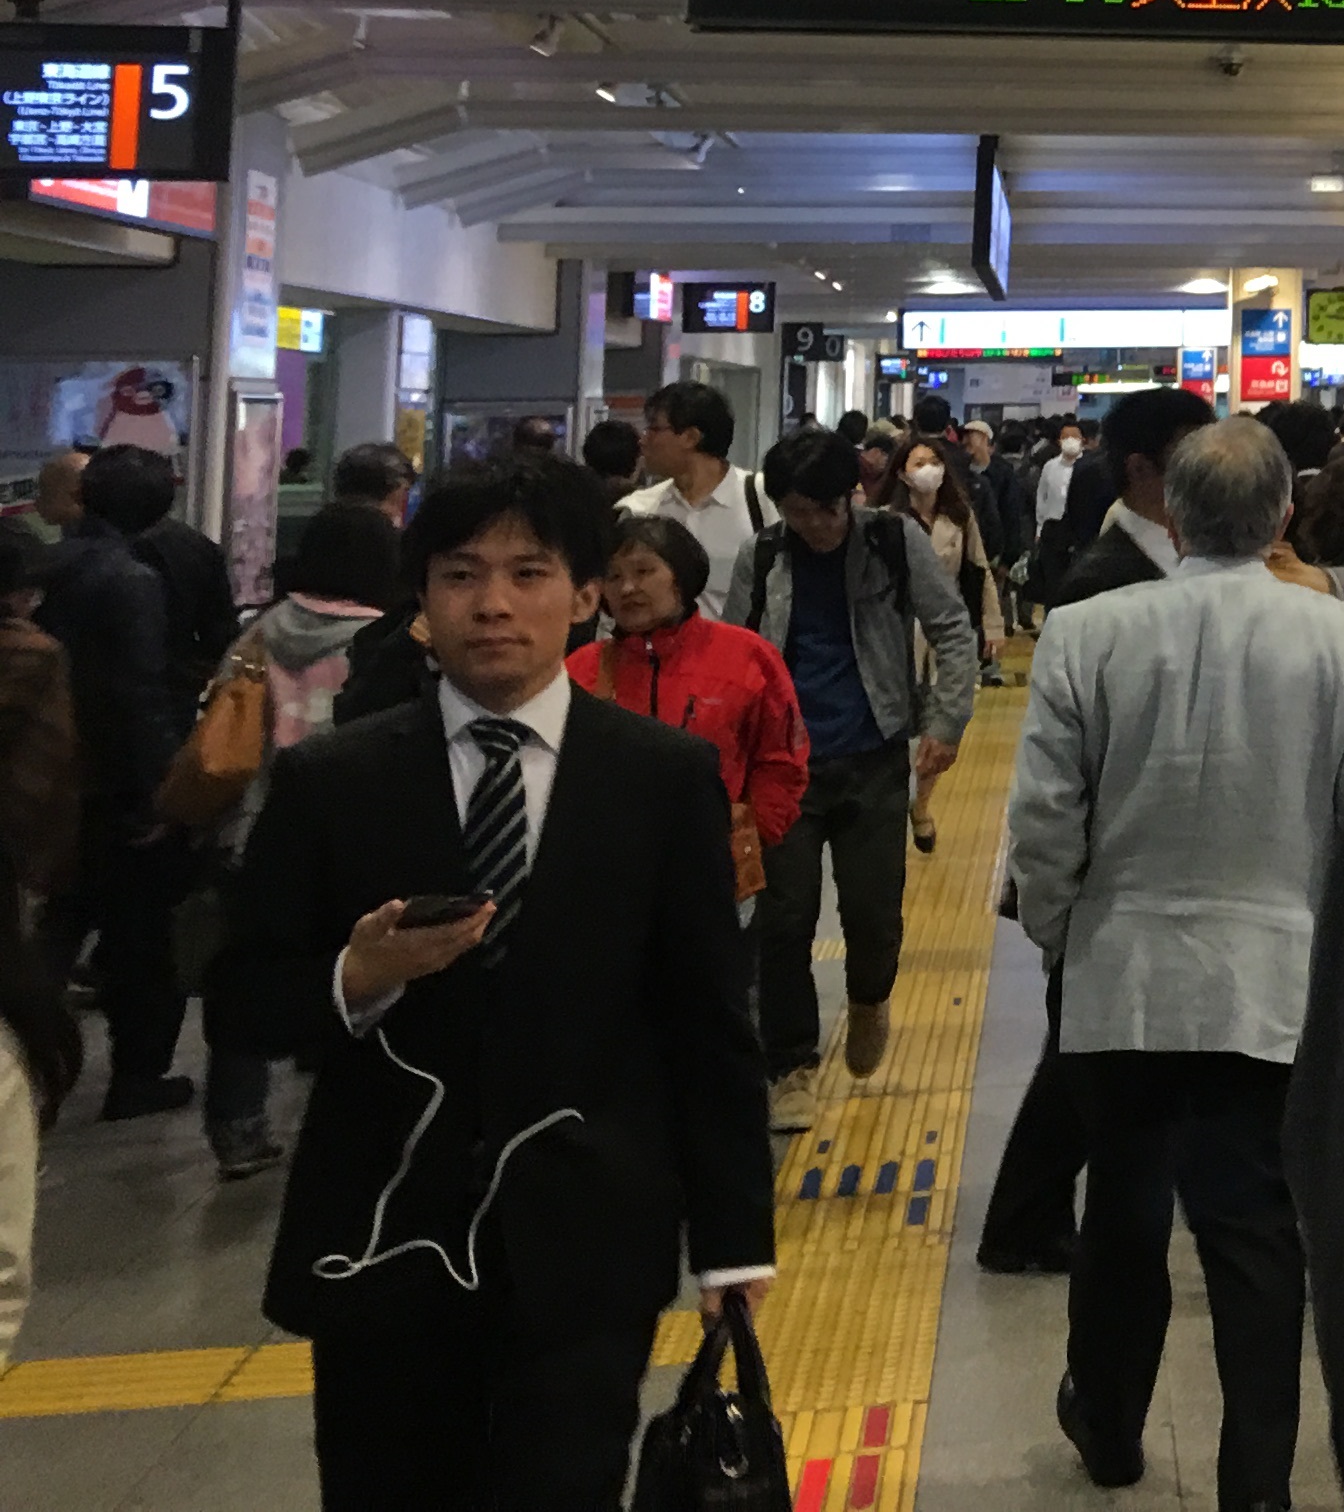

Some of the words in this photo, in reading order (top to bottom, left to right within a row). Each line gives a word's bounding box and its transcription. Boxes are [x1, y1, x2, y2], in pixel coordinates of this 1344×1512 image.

[150, 64, 190, 119] 5
[749, 290, 766, 314] 8
[796, 326, 814, 352] 9
